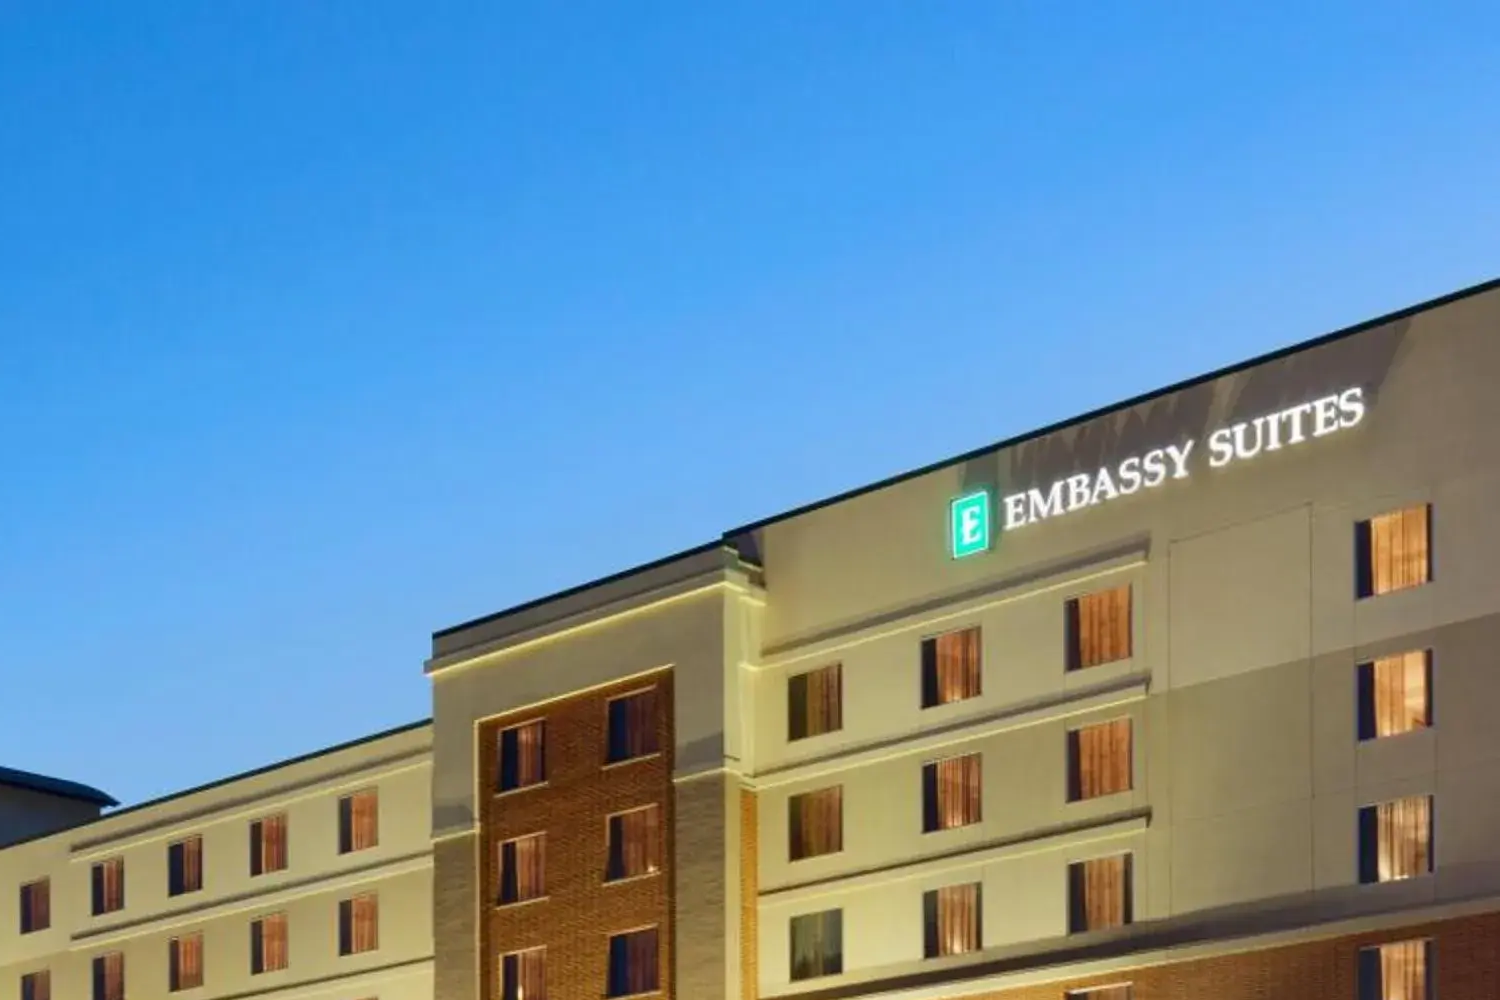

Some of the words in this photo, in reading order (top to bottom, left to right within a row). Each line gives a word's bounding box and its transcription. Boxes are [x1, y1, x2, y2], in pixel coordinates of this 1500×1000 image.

[962, 506, 981, 545] E
[1004, 439, 1194, 530] EMBASSY
[1209, 387, 1365, 467] SUITES
